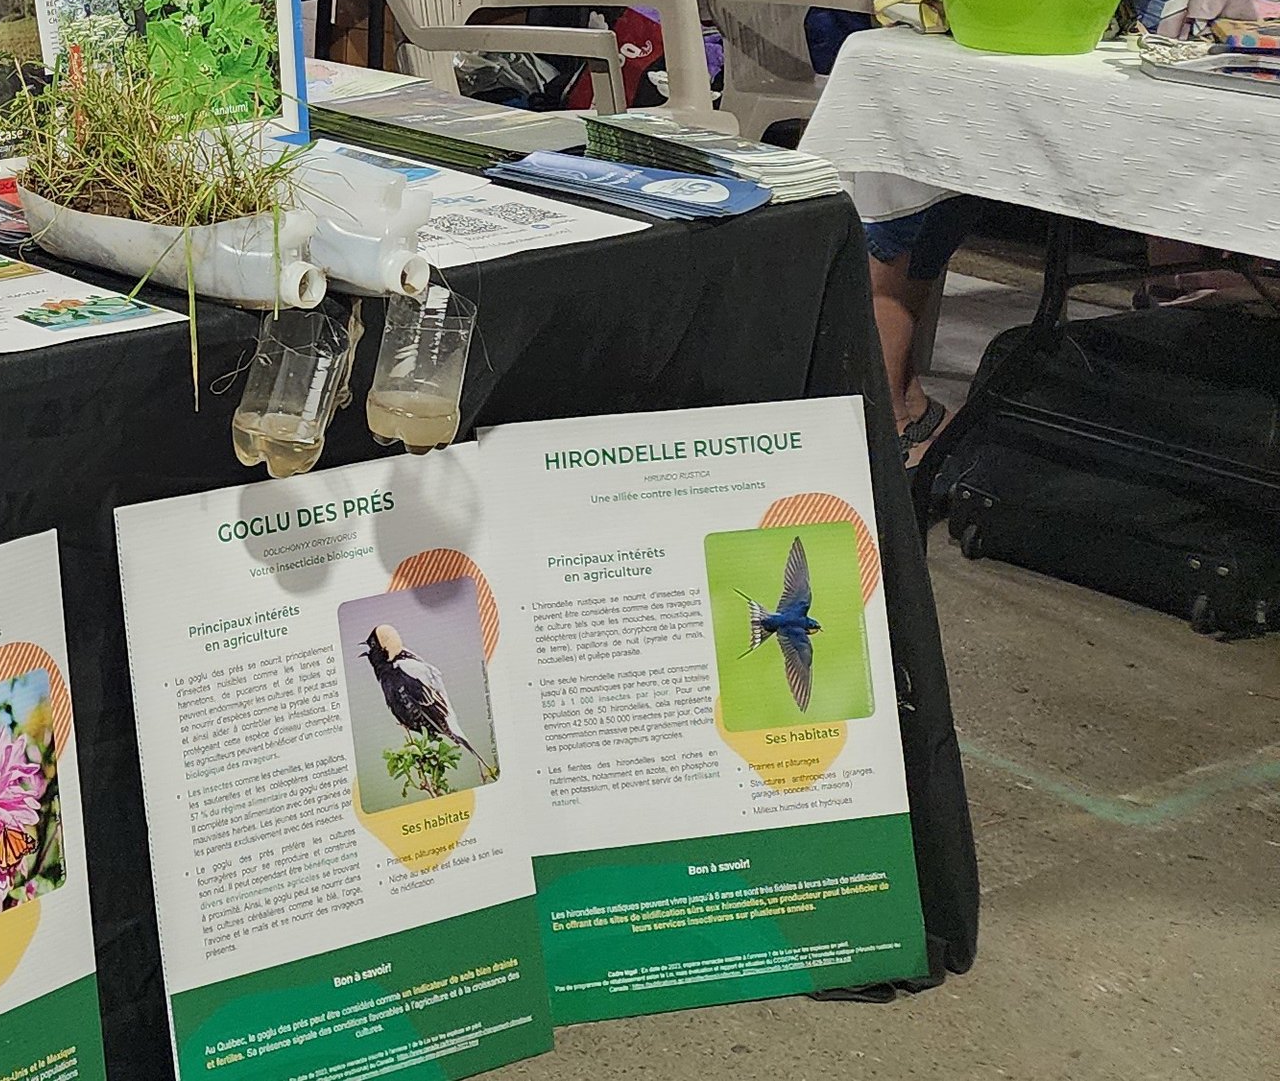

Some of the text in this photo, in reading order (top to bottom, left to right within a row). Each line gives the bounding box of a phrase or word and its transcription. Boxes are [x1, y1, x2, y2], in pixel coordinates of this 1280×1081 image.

[545, 432, 802, 470] HIRONDELLE RUSTIQUE
[218, 487, 395, 542] GOGLU DES PRÉS
[249, 544, 374, 577] Votre insecticide biologique
[401, 810, 470, 835] Ses habitats
